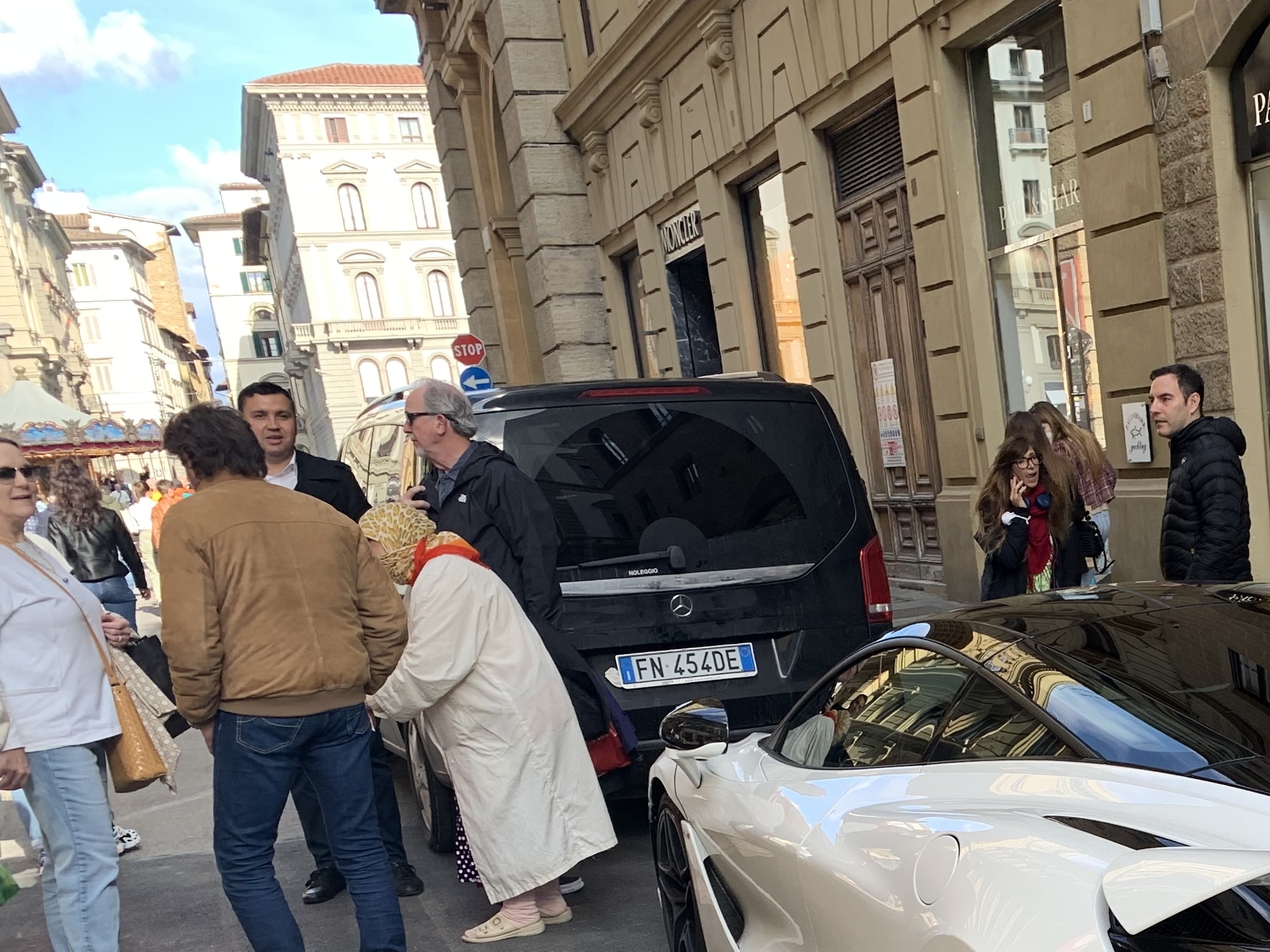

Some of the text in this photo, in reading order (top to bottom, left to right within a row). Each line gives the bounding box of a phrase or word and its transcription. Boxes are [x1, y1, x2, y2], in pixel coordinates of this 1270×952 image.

[1040, 178, 1080, 216] SHAR
[660, 211, 700, 253] MONCLER
[454, 343, 483, 357] STOP
[628, 567, 659, 576] NOLEGGIO
[635, 657, 665, 680] FN
[674, 649, 740, 675] 454DE
